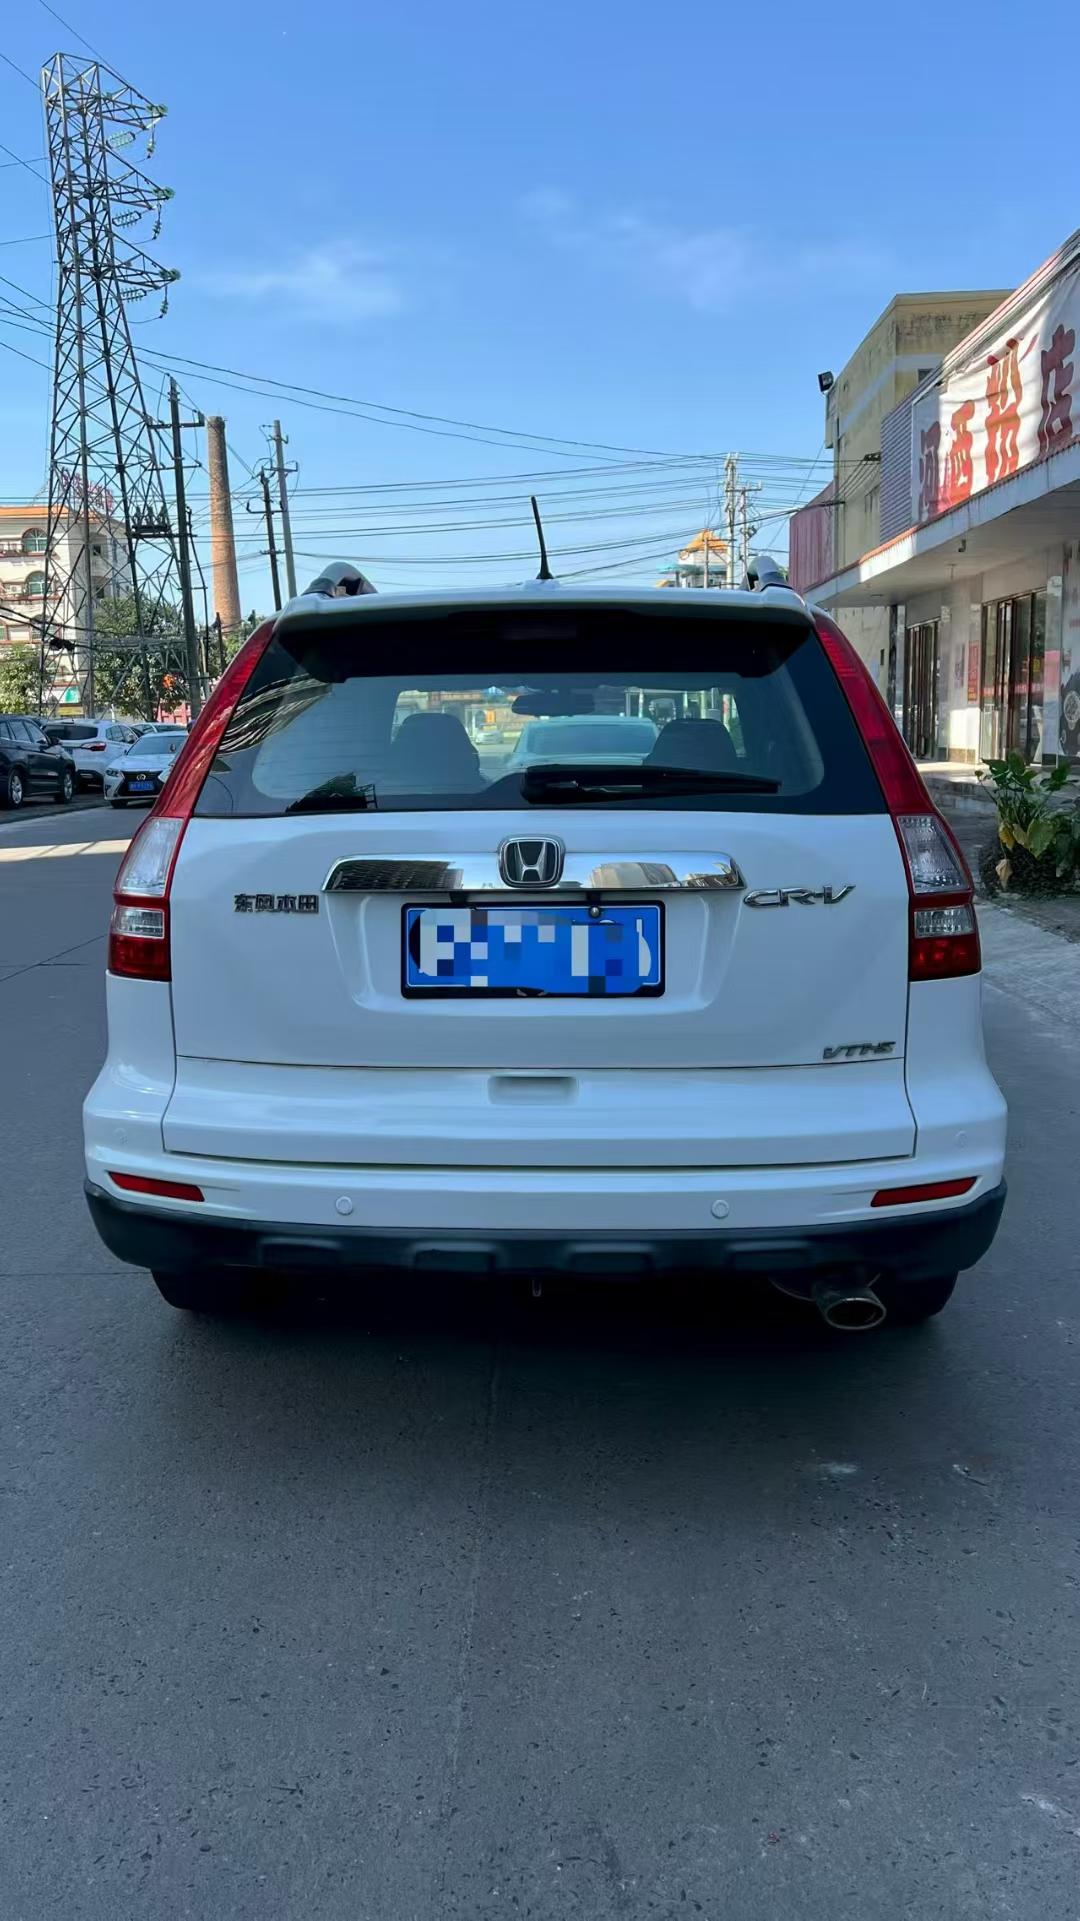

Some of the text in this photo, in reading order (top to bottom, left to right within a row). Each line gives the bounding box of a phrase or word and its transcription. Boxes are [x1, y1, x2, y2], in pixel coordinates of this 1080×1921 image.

[234, 893, 320, 913] 东风本田
[743, 885, 856, 907] CR-V
